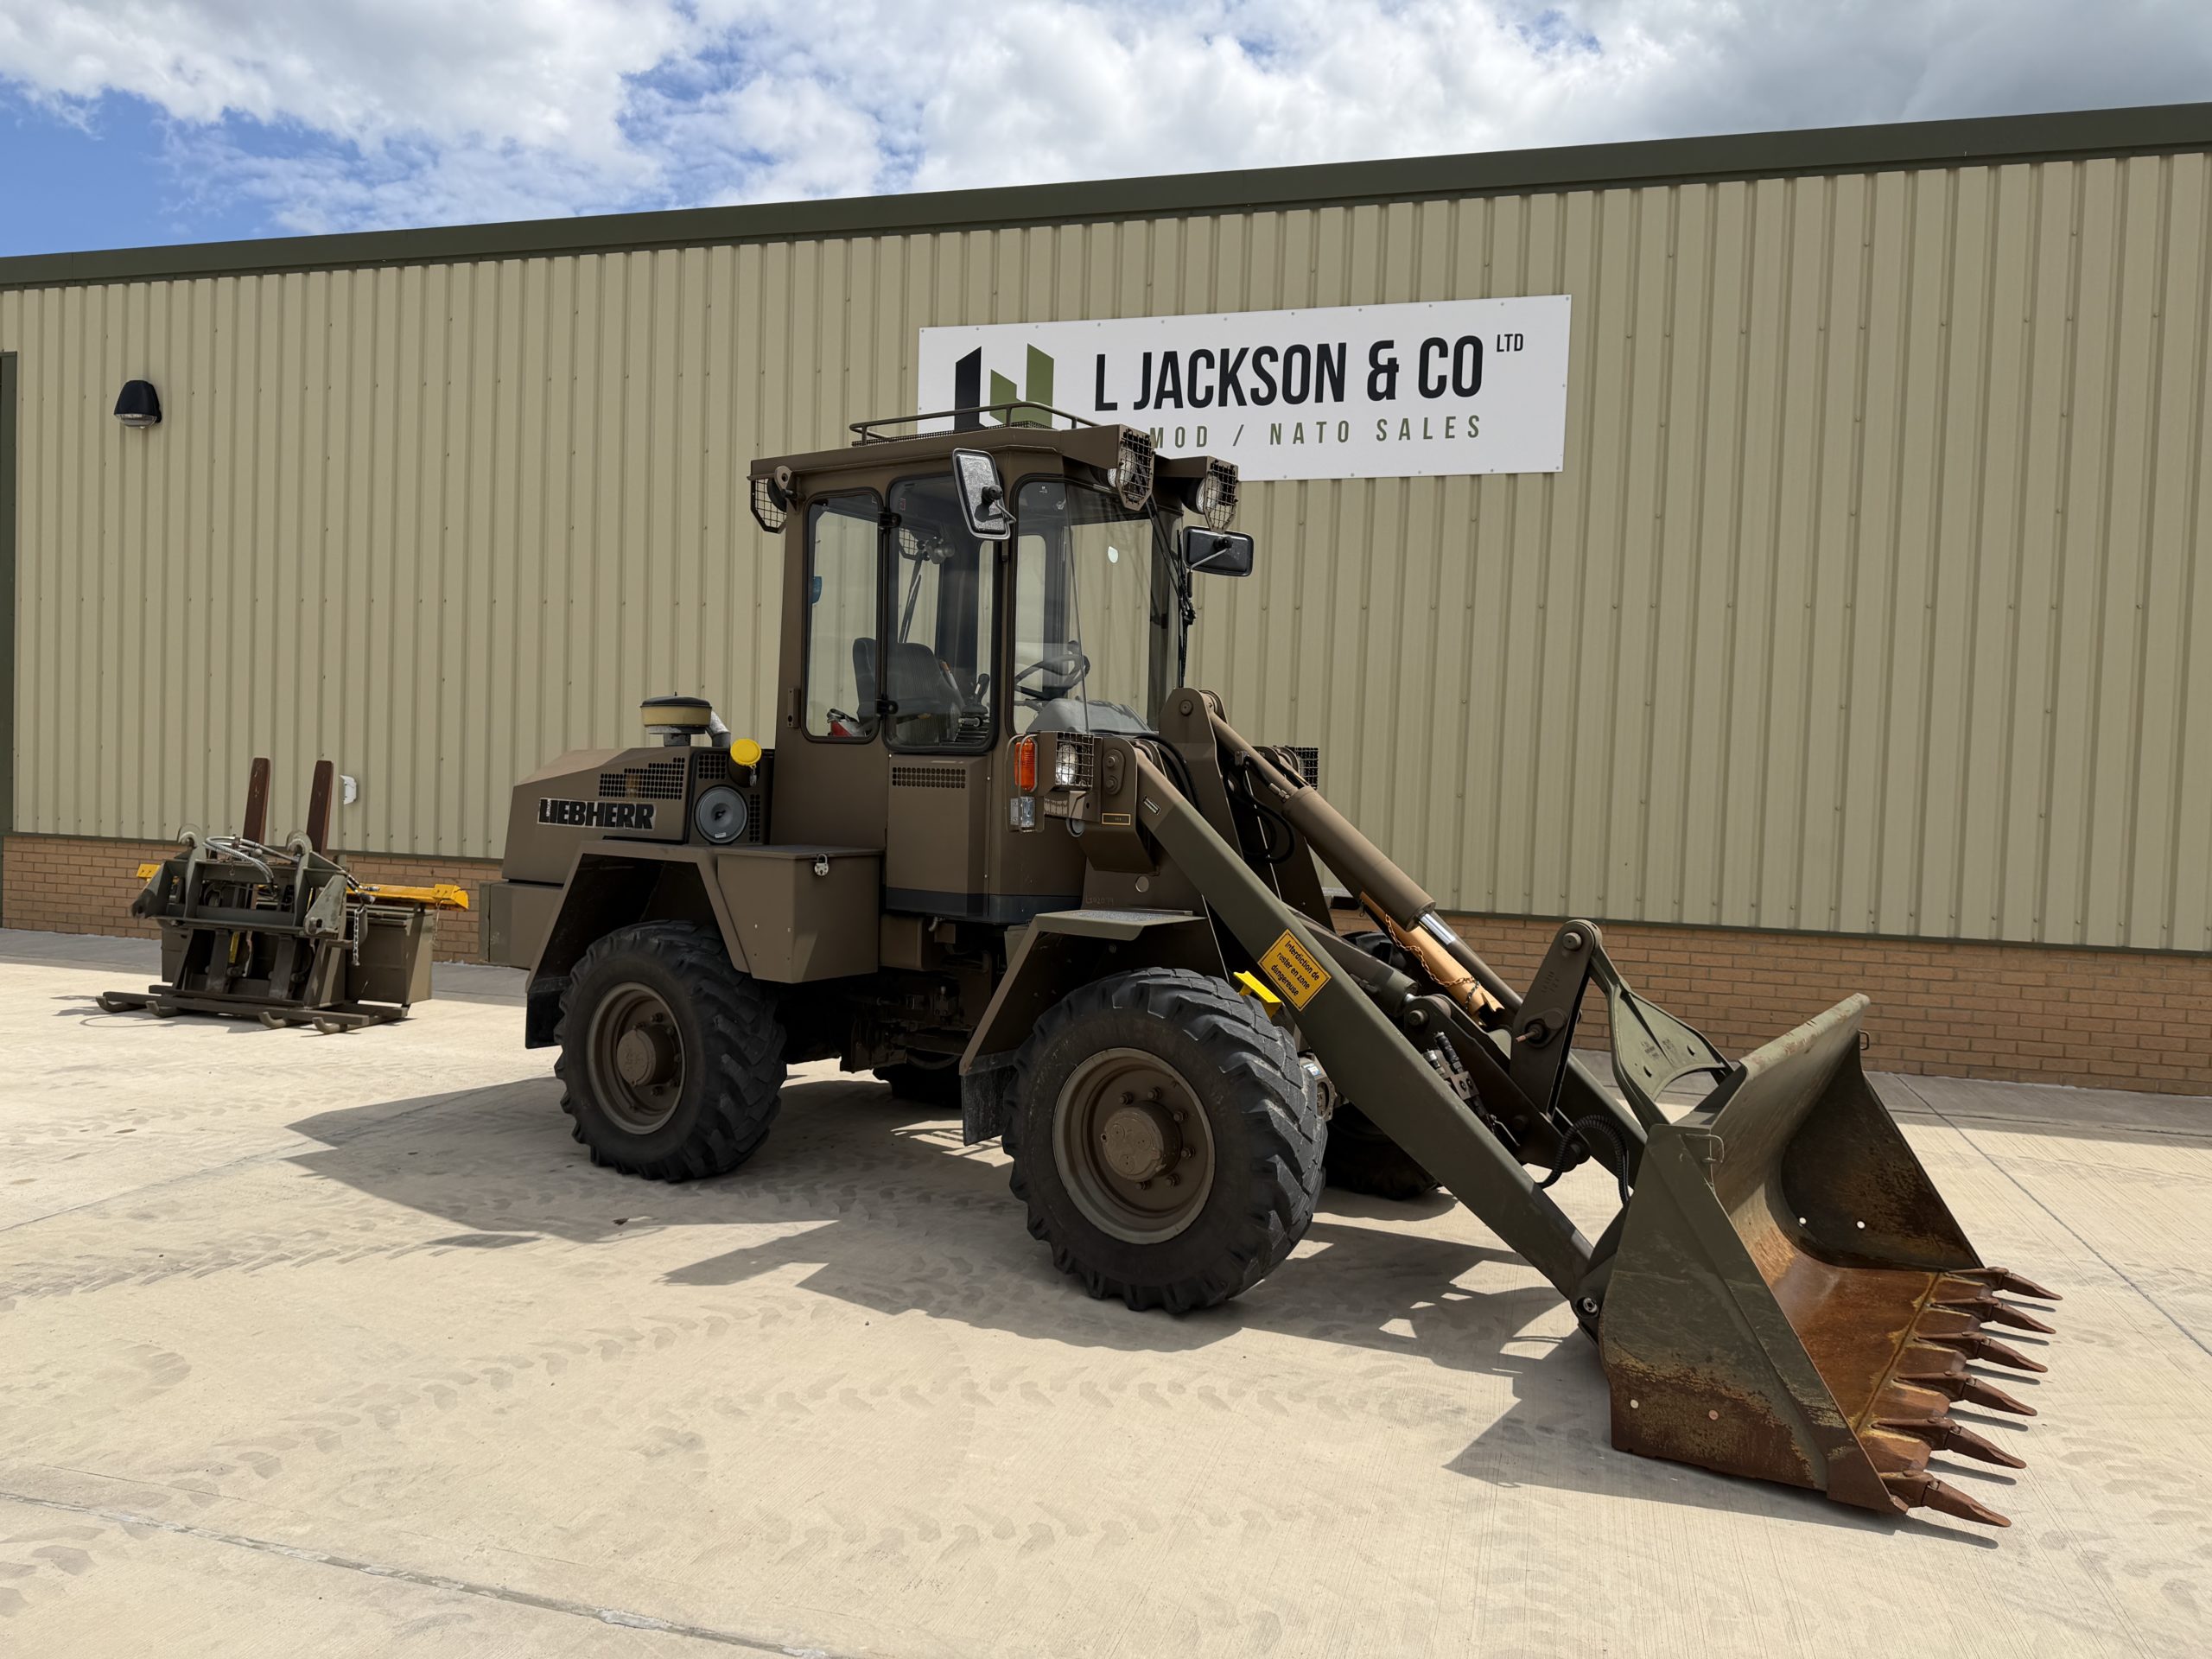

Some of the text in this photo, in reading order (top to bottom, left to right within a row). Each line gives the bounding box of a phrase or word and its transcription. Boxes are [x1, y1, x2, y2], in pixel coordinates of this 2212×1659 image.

[1095, 334, 1524, 412] L JACKSON & CO LTD
[1150, 426, 1208, 448] MOD
[1270, 421, 1350, 446] NATO
[1376, 415, 1480, 442] SALES
[538, 798, 654, 830] LIEBHERR
[1276, 952, 1310, 989] rester en zone
[1285, 940, 1319, 981] Interdiction de
[1271, 964, 1300, 996] dangereuse
